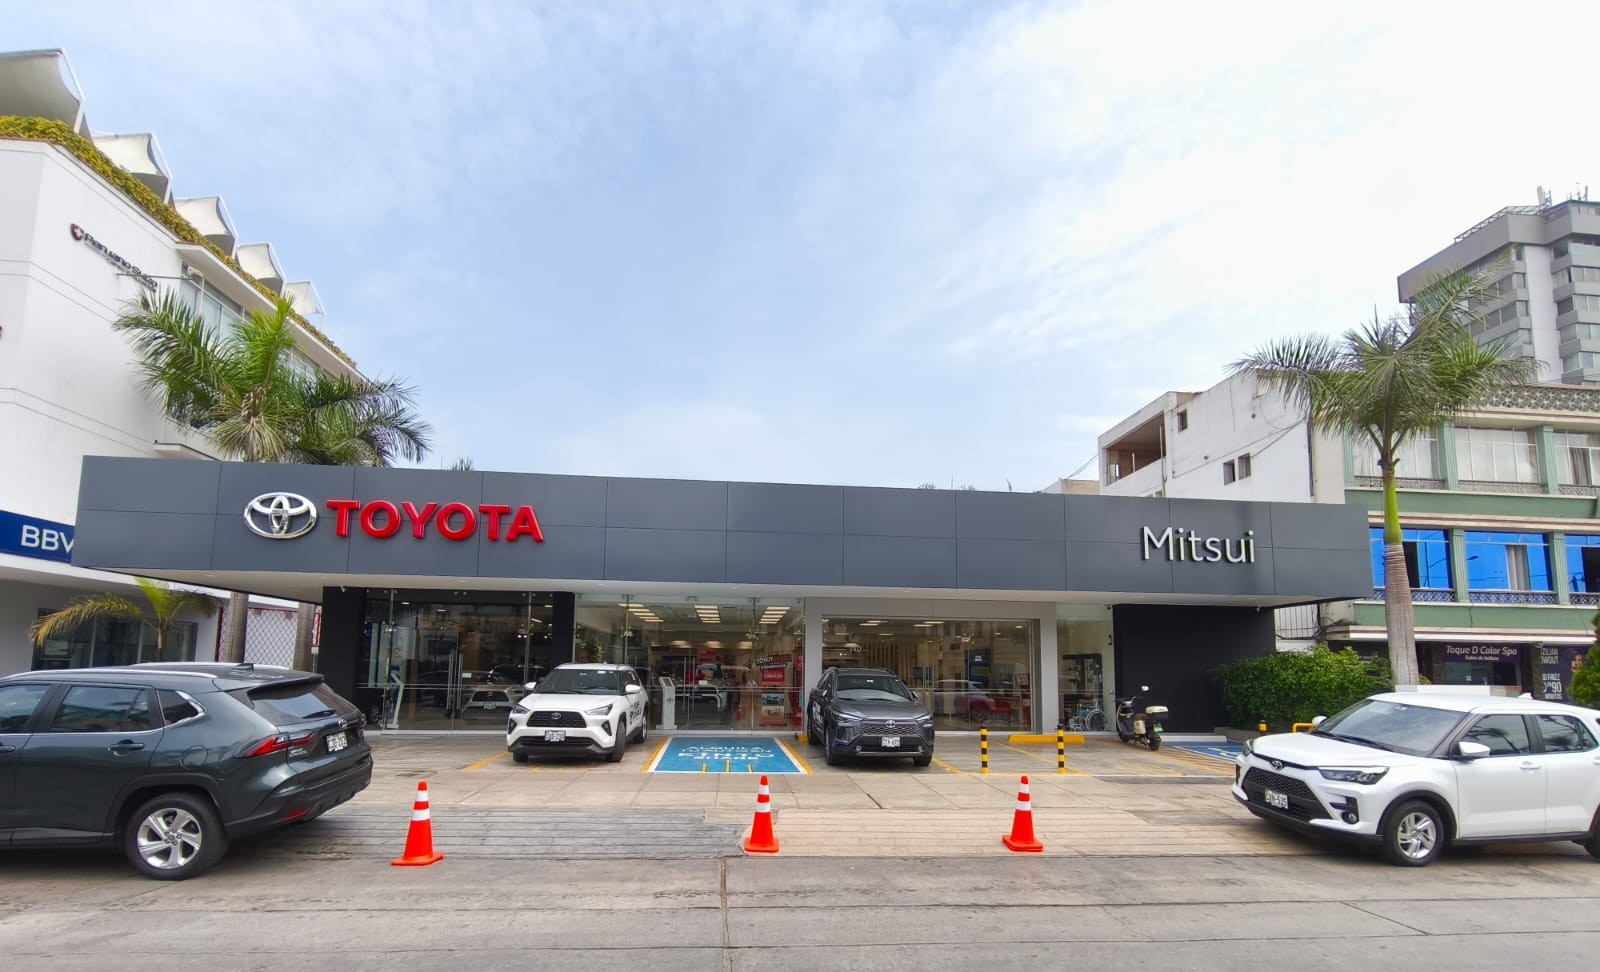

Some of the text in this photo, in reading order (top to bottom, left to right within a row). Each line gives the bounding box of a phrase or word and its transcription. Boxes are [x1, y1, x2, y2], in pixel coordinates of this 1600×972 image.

[326, 498, 545, 543] TOYOTA
[21, 524, 75, 554] BBV
[1141, 525, 1256, 563] Mitsui
[1445, 645, 1518, 657] Toque D Color Spa
[1551, 681, 1562, 693] 90
